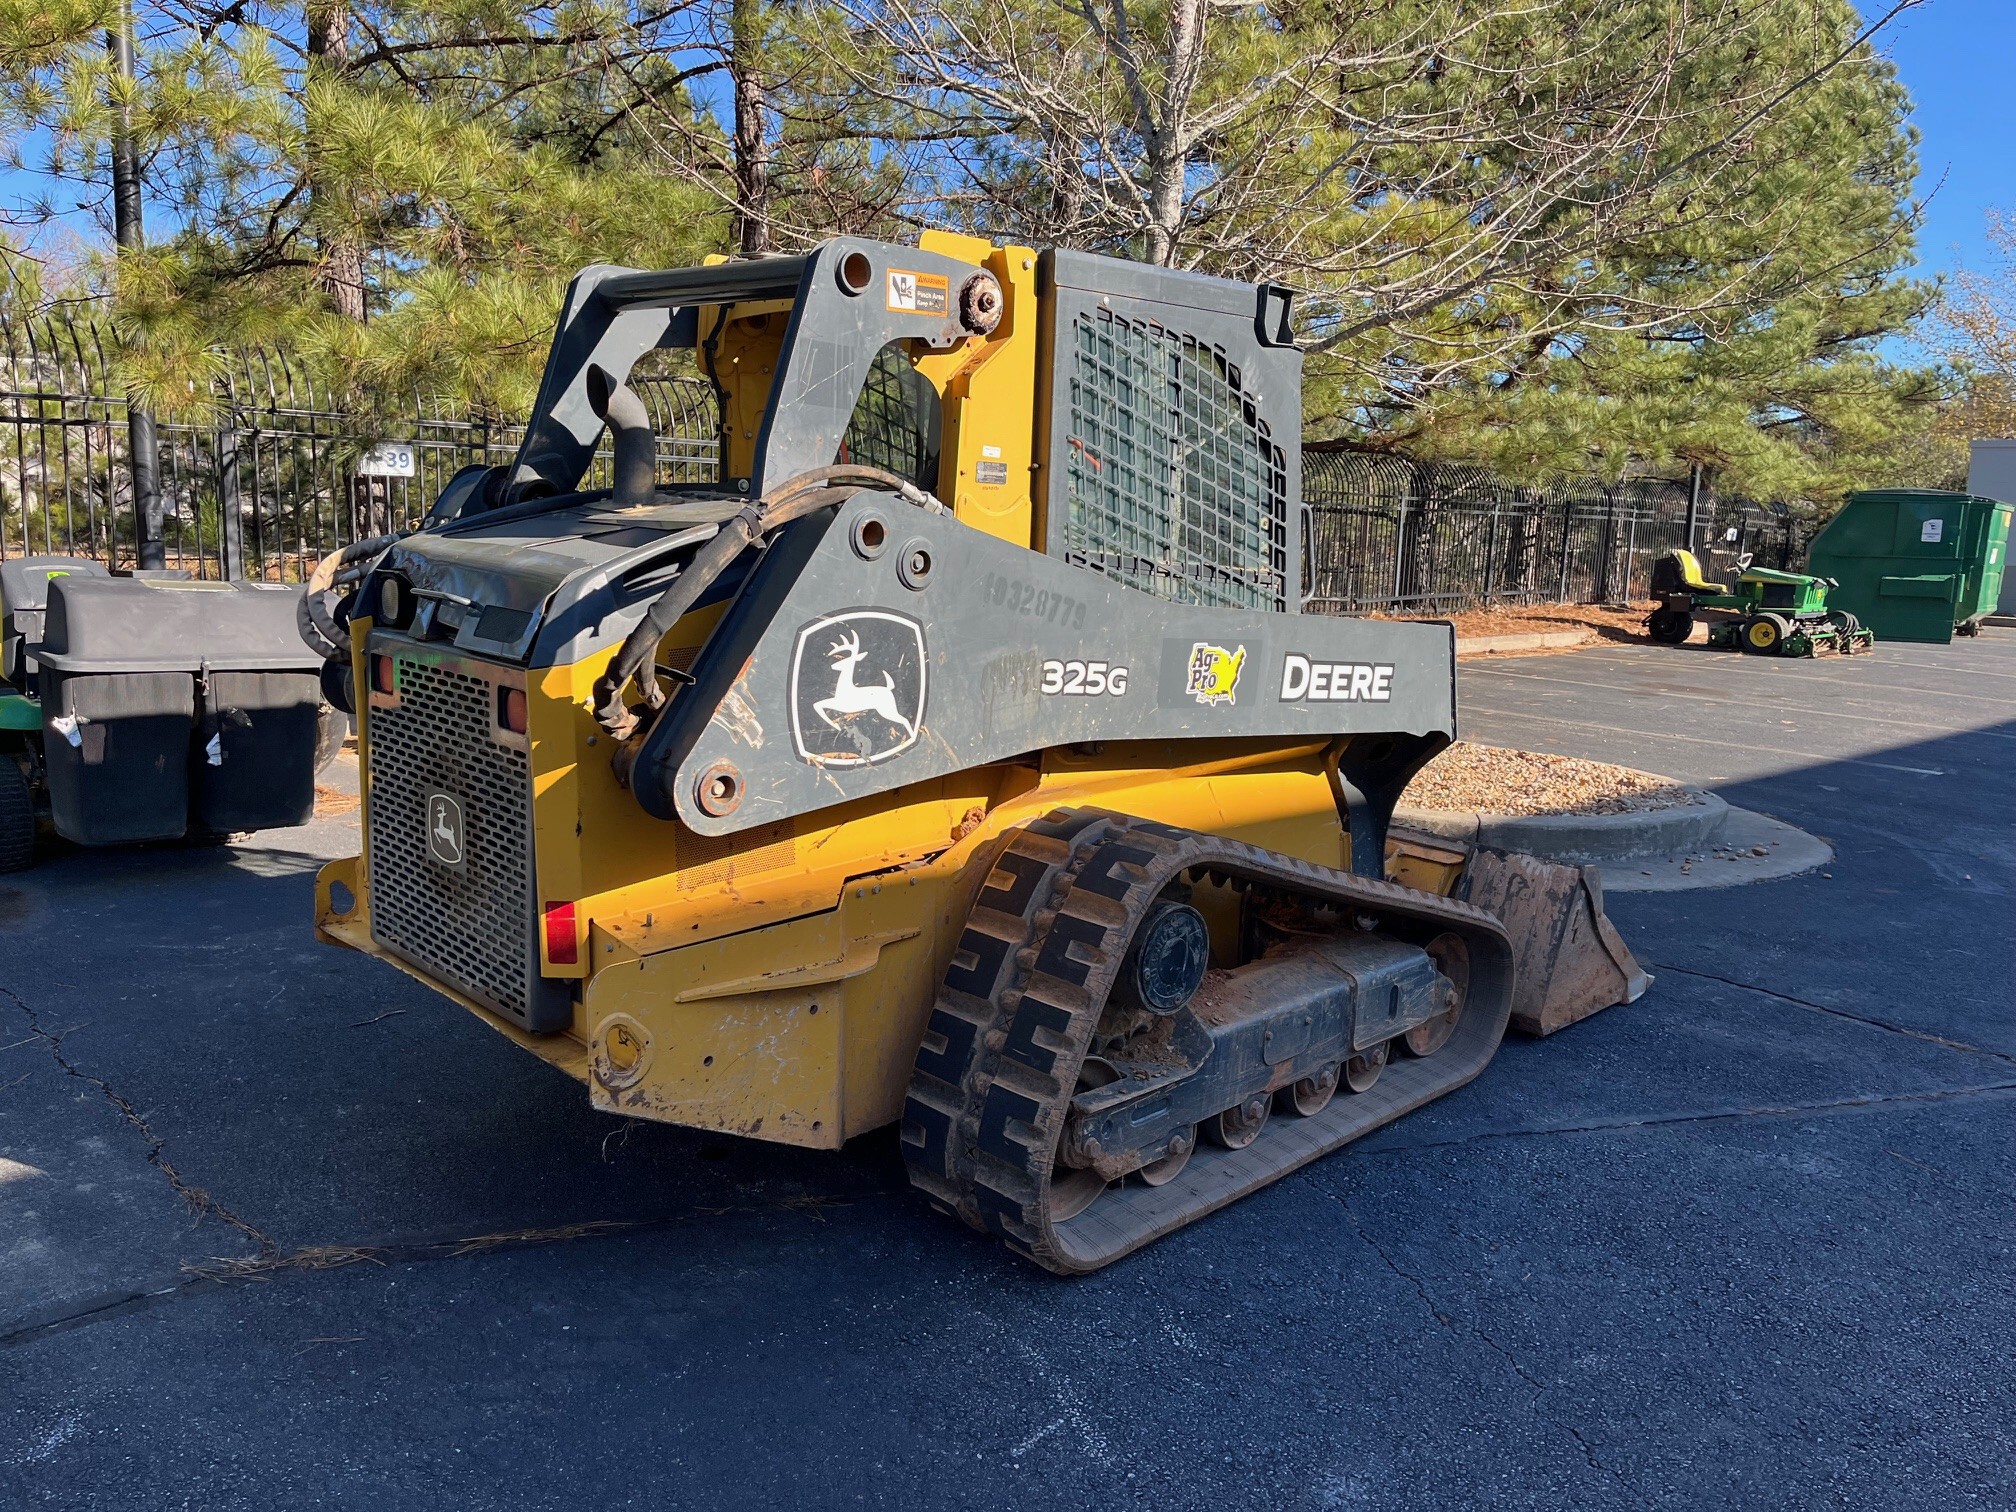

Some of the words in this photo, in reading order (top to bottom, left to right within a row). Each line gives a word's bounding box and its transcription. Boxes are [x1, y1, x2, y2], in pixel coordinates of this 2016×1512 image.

[1042, 660, 1129, 697] 325G
[1190, 669, 1217, 690] Pro
[1279, 651, 1395, 704] DEERE
